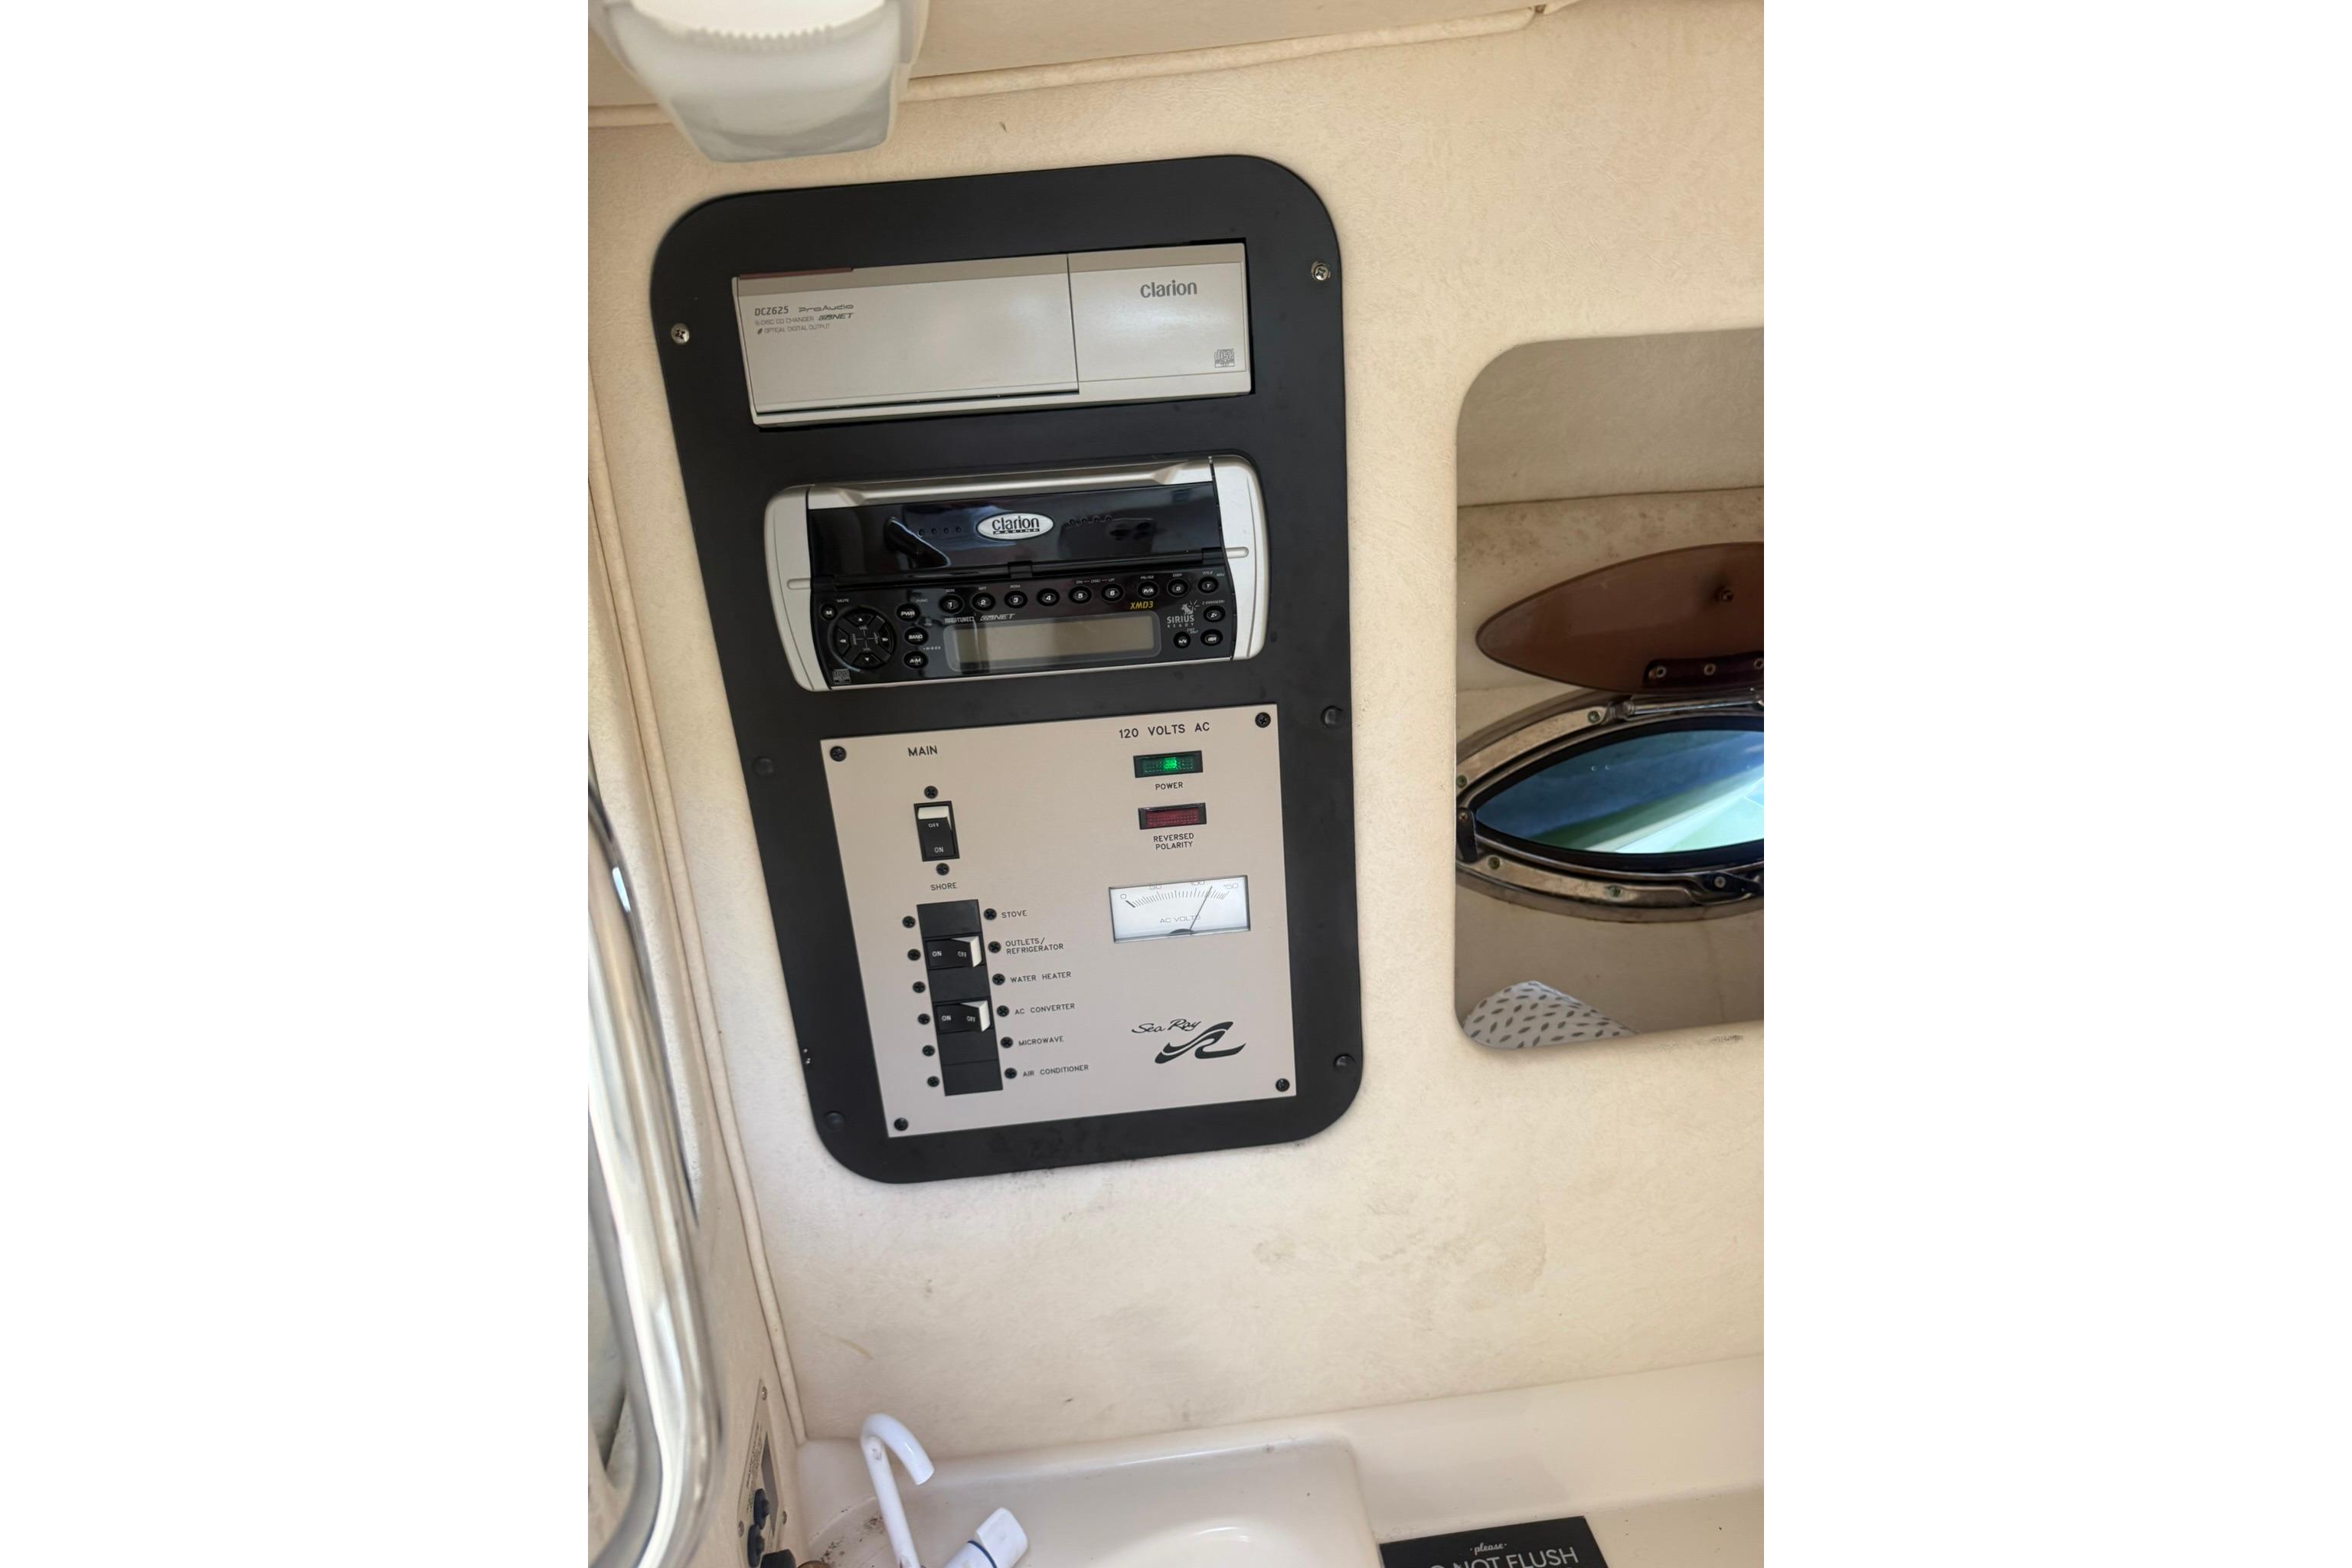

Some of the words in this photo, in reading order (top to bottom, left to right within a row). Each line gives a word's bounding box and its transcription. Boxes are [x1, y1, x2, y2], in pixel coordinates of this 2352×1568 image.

[1140, 279, 1197, 299] clarion
[755, 306, 789, 316] DCZ625
[992, 515, 1040, 531] clarion
[1130, 601, 1154, 609] XMD3
[1166, 615, 1194, 624] SIRIUS
[1119, 728, 1138, 739] 120
[1148, 724, 1186, 736] VOLTS
[1194, 722, 1210, 732] AC
[907, 744, 938, 757] MAIN
[1155, 782, 1183, 791] POWER
[1153, 832, 1194, 842] REVERSED
[1155, 841, 1194, 851] POLARITY
[930, 882, 957, 891] SHORE
[1001, 910, 1027, 919] STOVE
[1005, 937, 1046, 947] OUTLETS/
[1006, 943, 1064, 955] REFRIGERATOR
[1010, 975, 1037, 983] WATER
[1042, 972, 1072, 980] HEATER
[1030, 1003, 1076, 1014] CONVERTER
[1132, 1023, 1165, 1034] Sea
[1167, 1018, 1202, 1032] Ray
[1018, 1035, 1064, 1047] MICROWAVE
[1040, 1064, 1089, 1076] CONDITIONER
[1474, 1541, 1504, 1556] please
[1506, 1547, 1579, 1568] FLUSH
